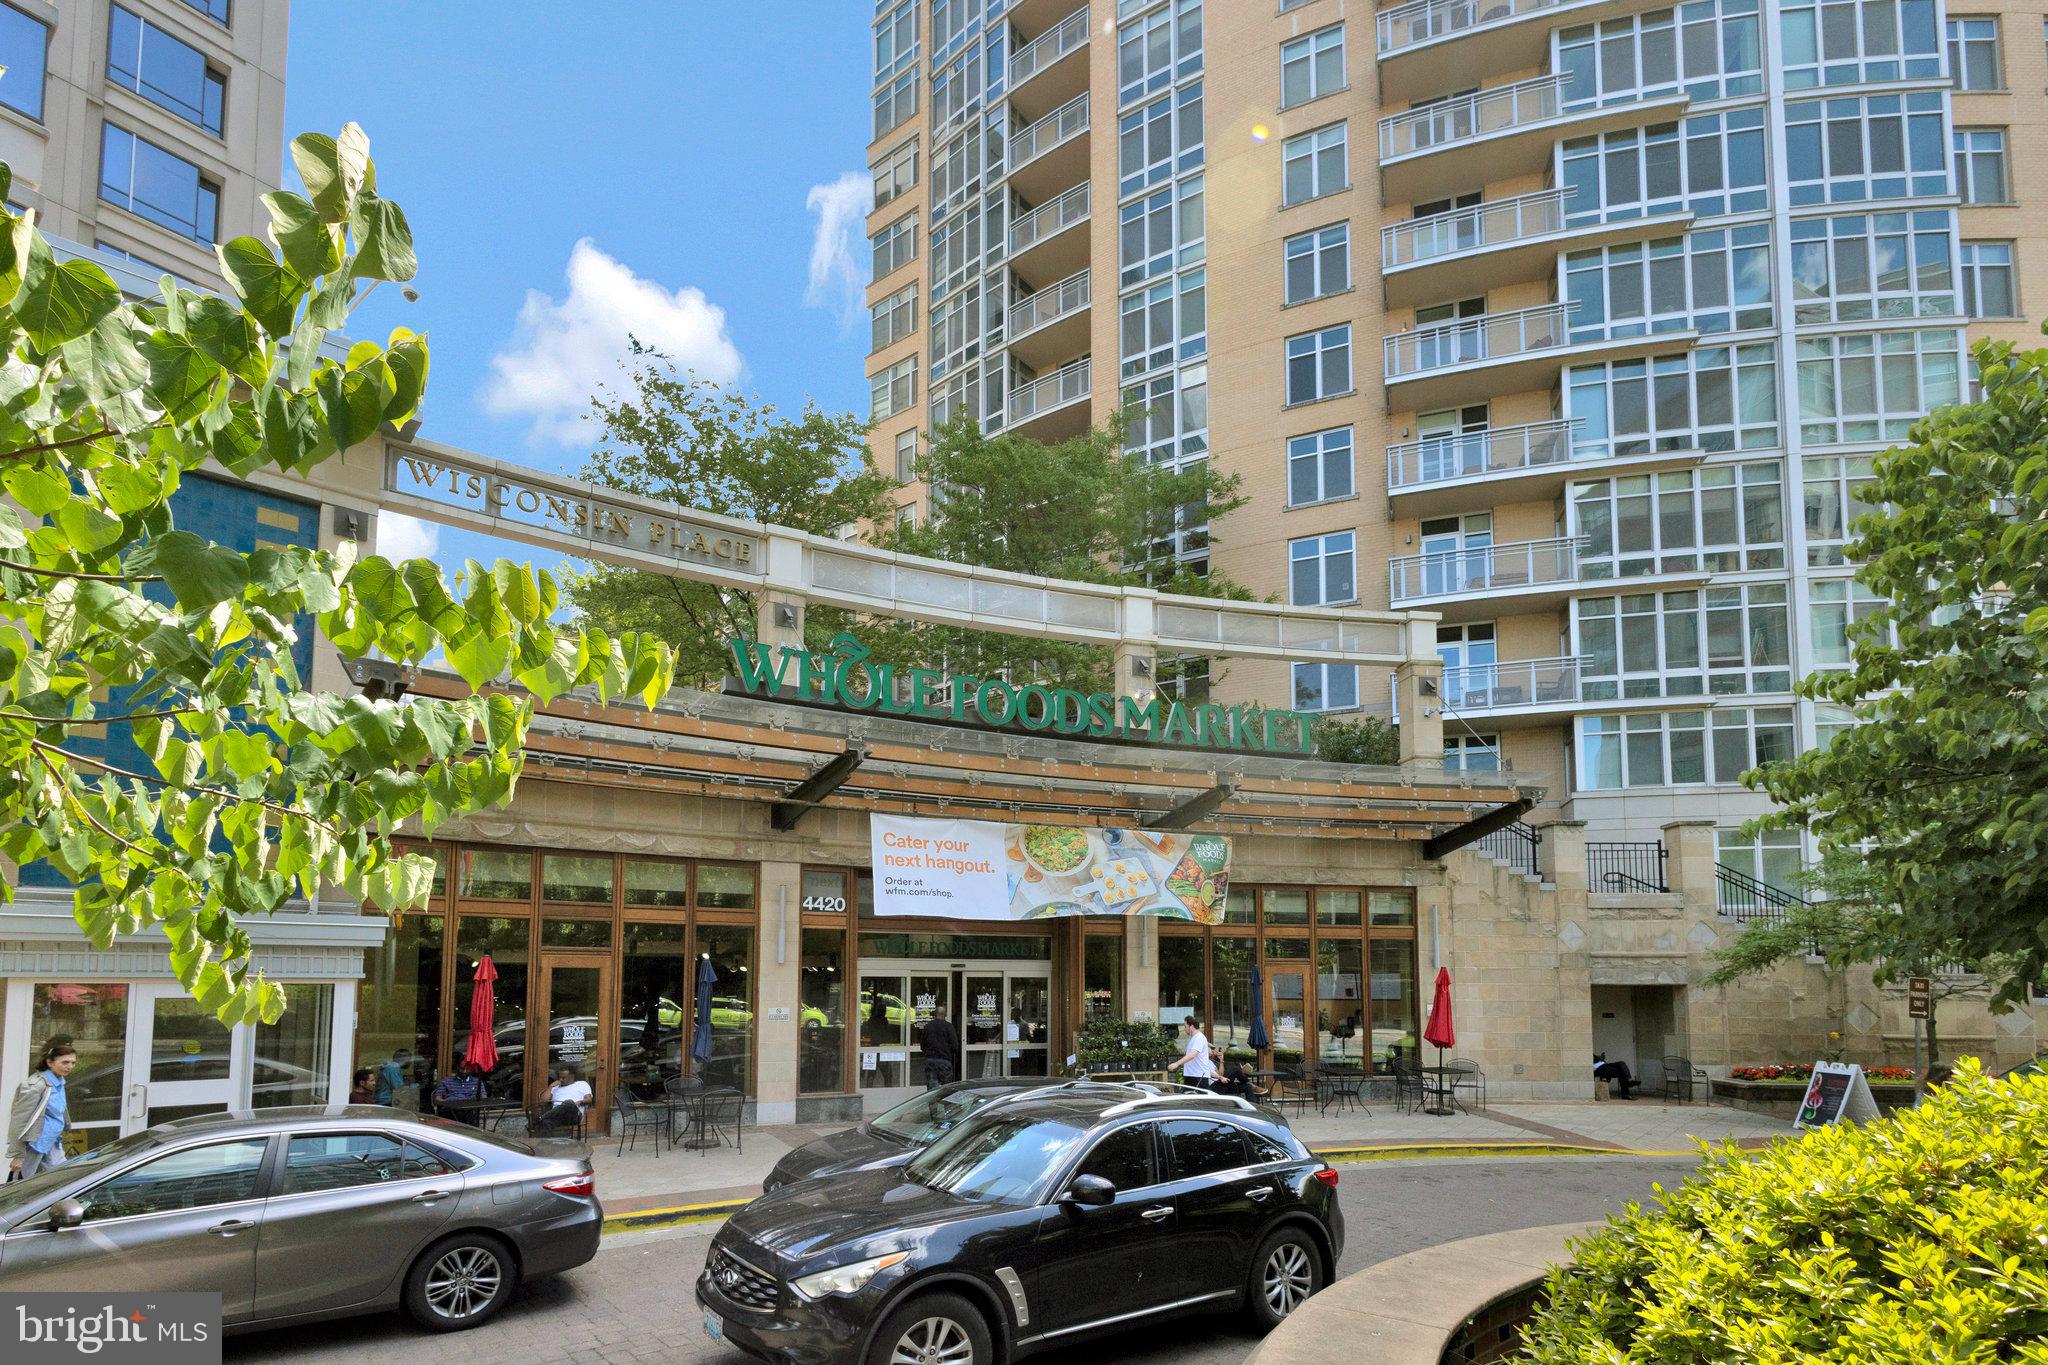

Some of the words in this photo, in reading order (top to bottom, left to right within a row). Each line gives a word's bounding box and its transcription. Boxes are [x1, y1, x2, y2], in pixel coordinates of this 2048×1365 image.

[402, 456, 632, 536] WISCONSIN
[648, 519, 754, 565] PLACE
[731, 633, 948, 714] WHOLE
[949, 675, 1115, 737] FOODS
[1120, 695, 1323, 754] MARKET
[883, 832, 929, 850] Cater
[933, 840, 969, 854] your
[1192, 841, 1225, 851] WHOLE
[884, 853, 921, 868] next
[925, 854, 996, 875] hangout.
[884, 876, 912, 887] Order
[914, 879, 923, 887] at
[885, 887, 954, 898] wfm.com/shop.
[803, 896, 846, 912] 4420
